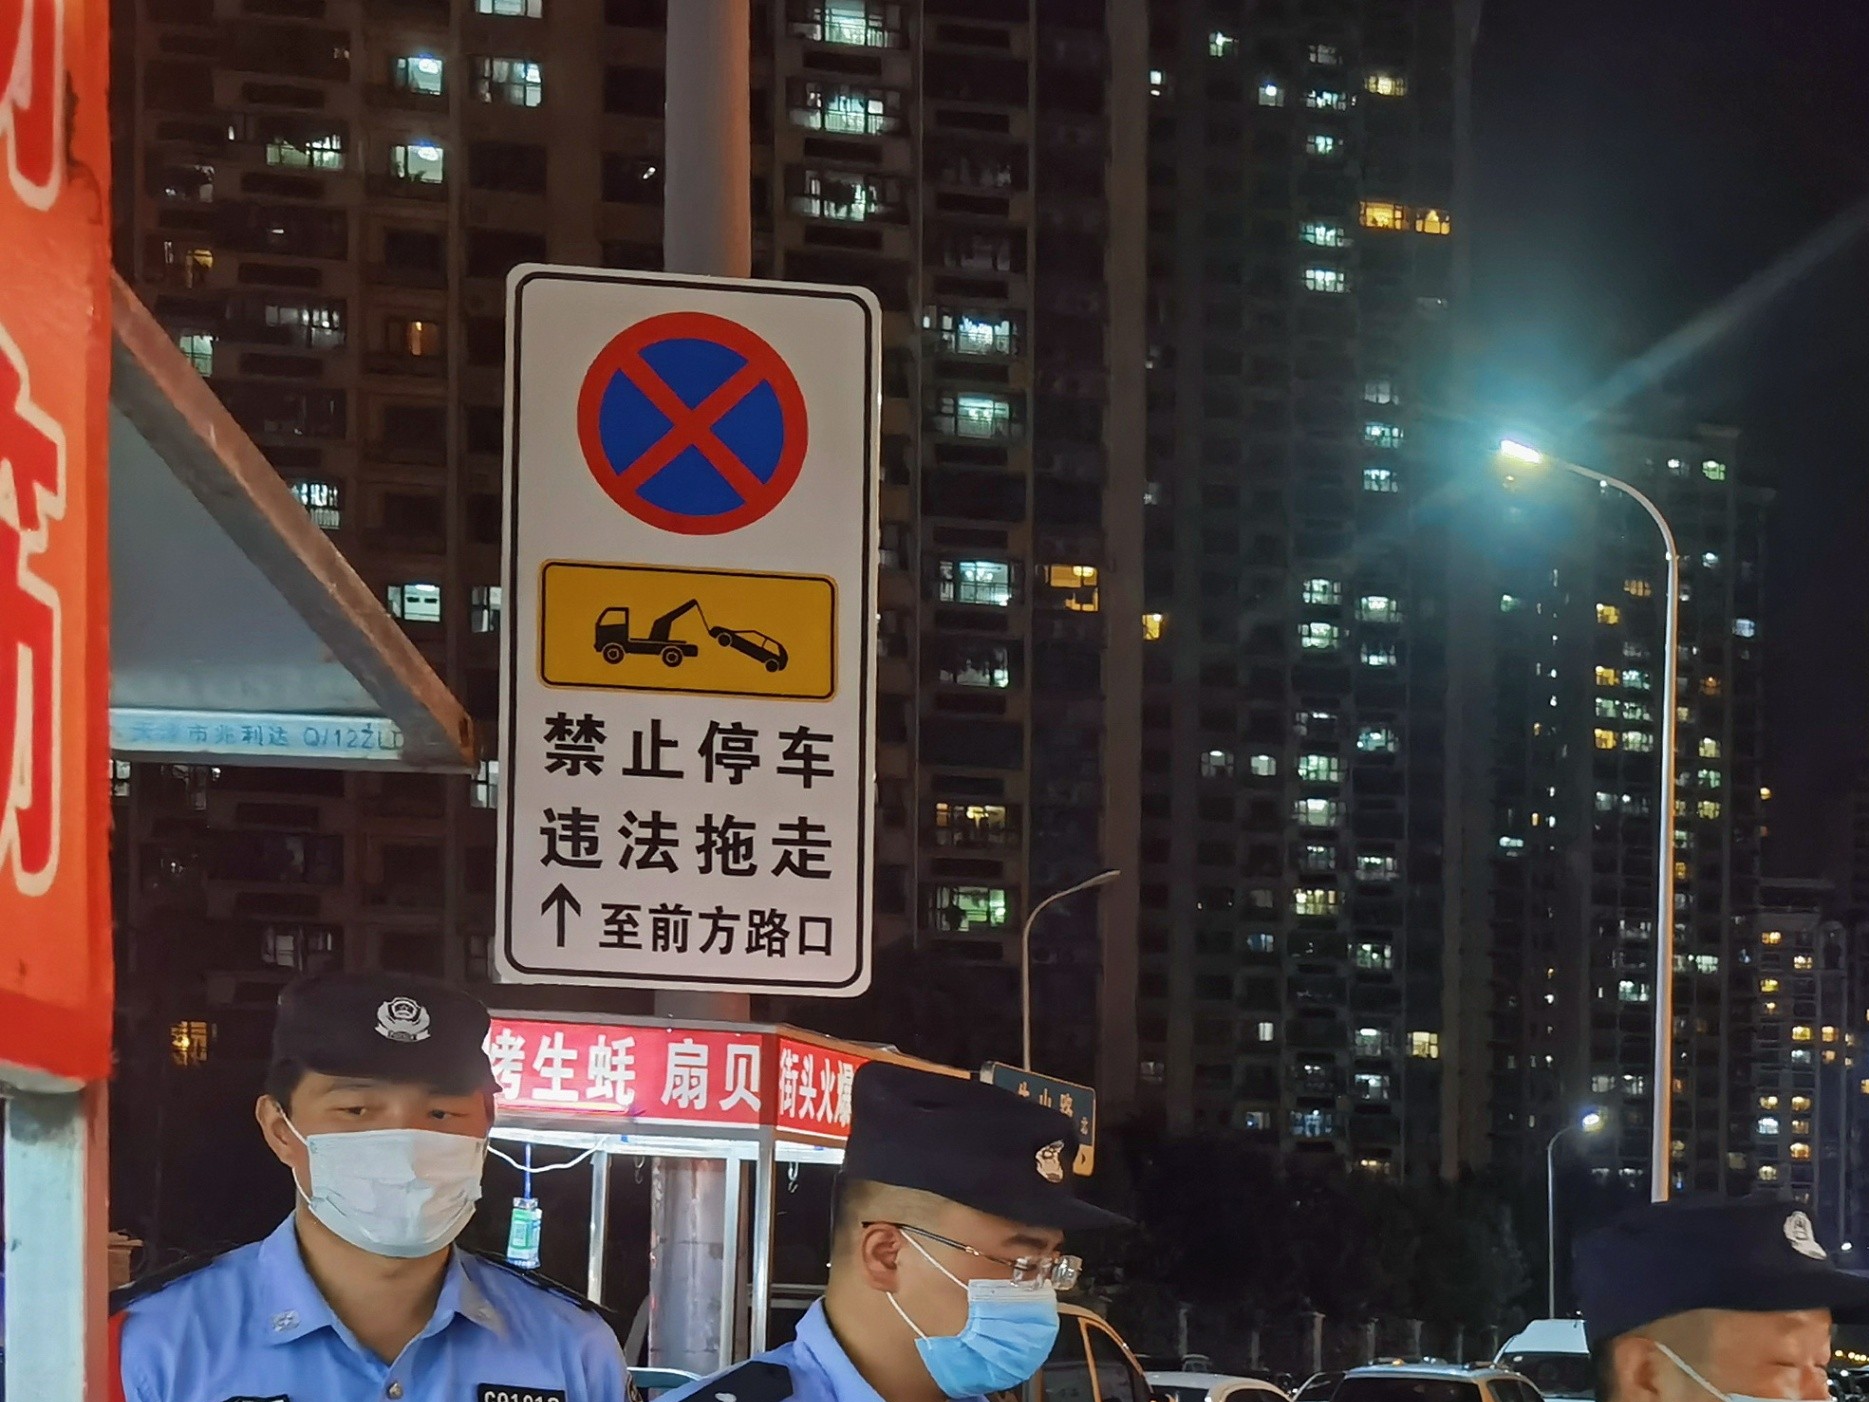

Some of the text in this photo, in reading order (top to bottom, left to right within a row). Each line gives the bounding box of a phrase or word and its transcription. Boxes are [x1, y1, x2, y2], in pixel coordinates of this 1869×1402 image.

[543, 712, 835, 789] 禁止停车
[540, 806, 833, 879] 违法拖走
[599, 902, 833, 958] 至前方路口
[490, 1027, 763, 1113] 烤生蚝 扇贝
[778, 1047, 855, 1127] 街头火爆
